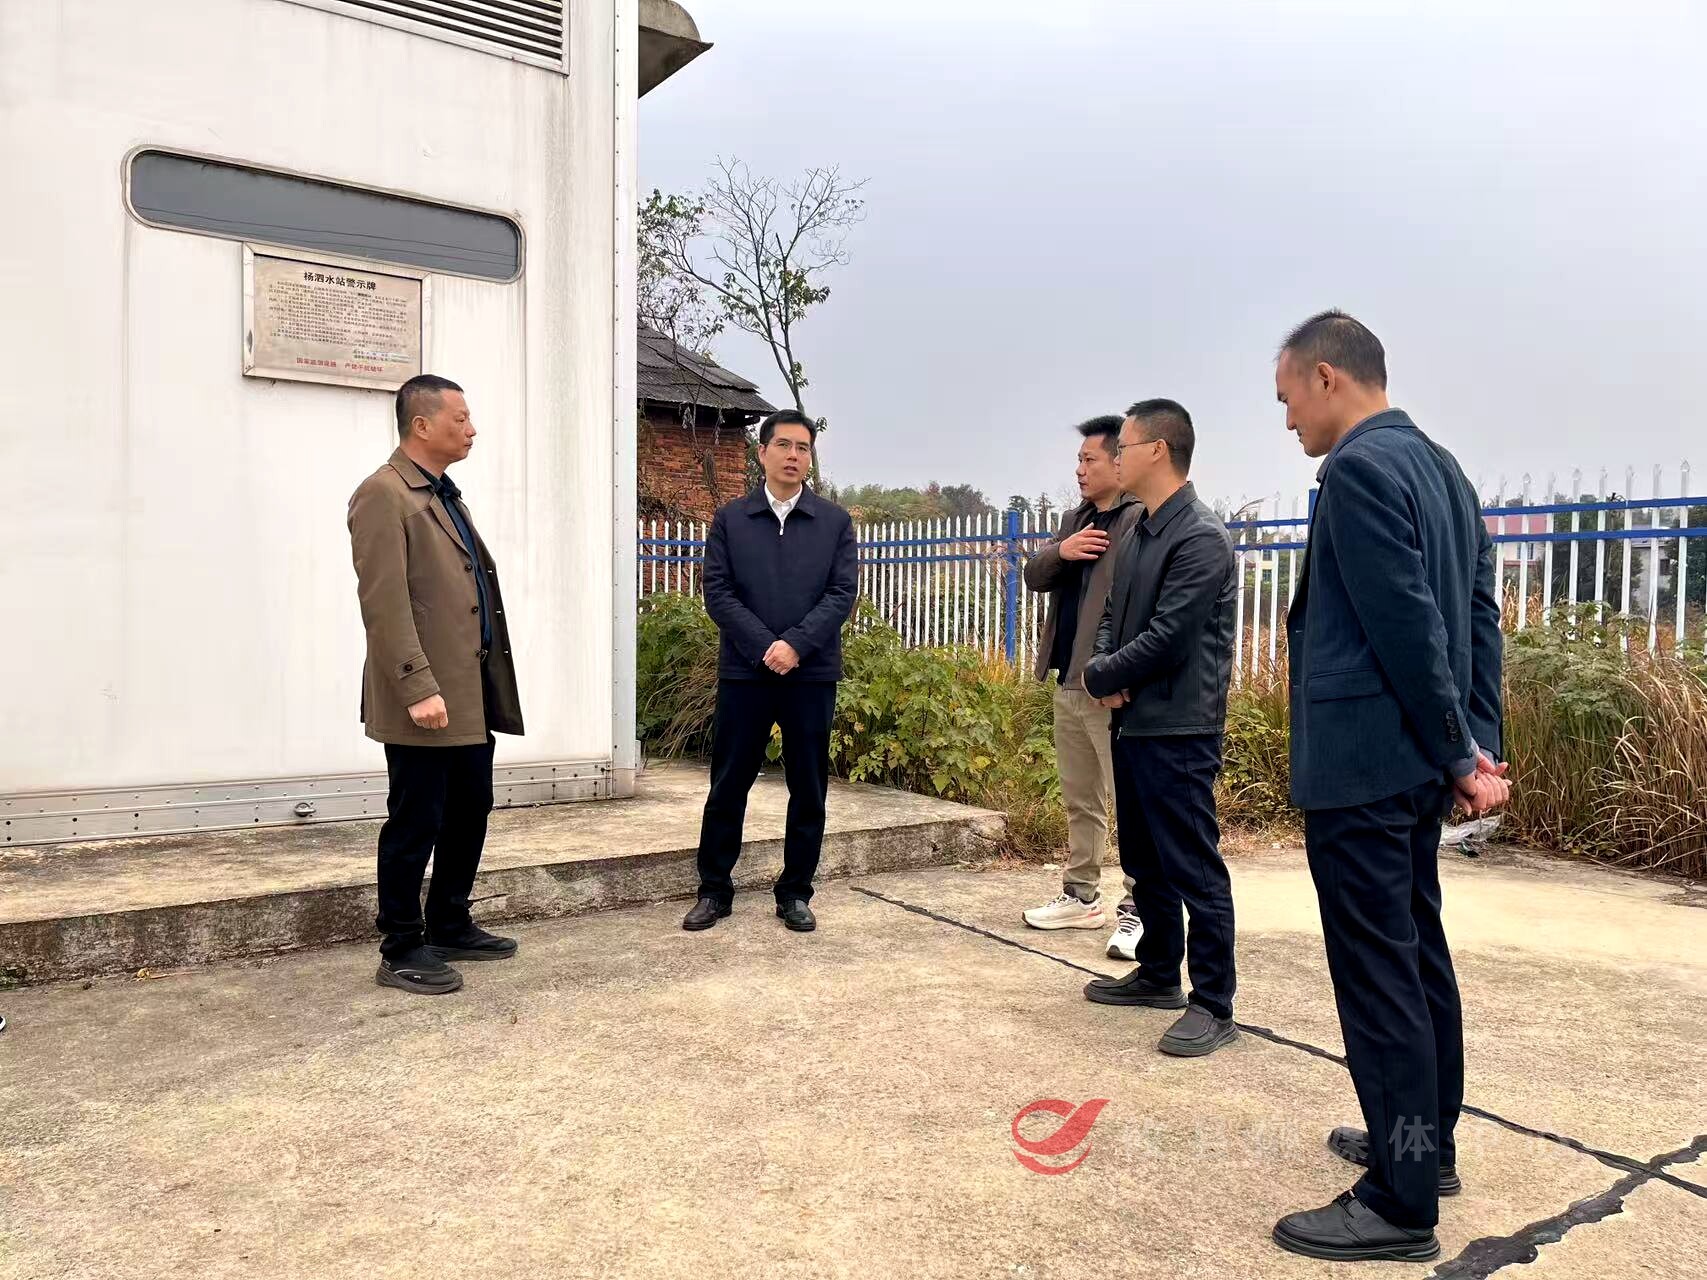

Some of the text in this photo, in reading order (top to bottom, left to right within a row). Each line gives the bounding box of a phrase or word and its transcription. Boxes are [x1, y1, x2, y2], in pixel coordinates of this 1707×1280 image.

[304, 271, 376, 290] 杨泗水站警示牌
